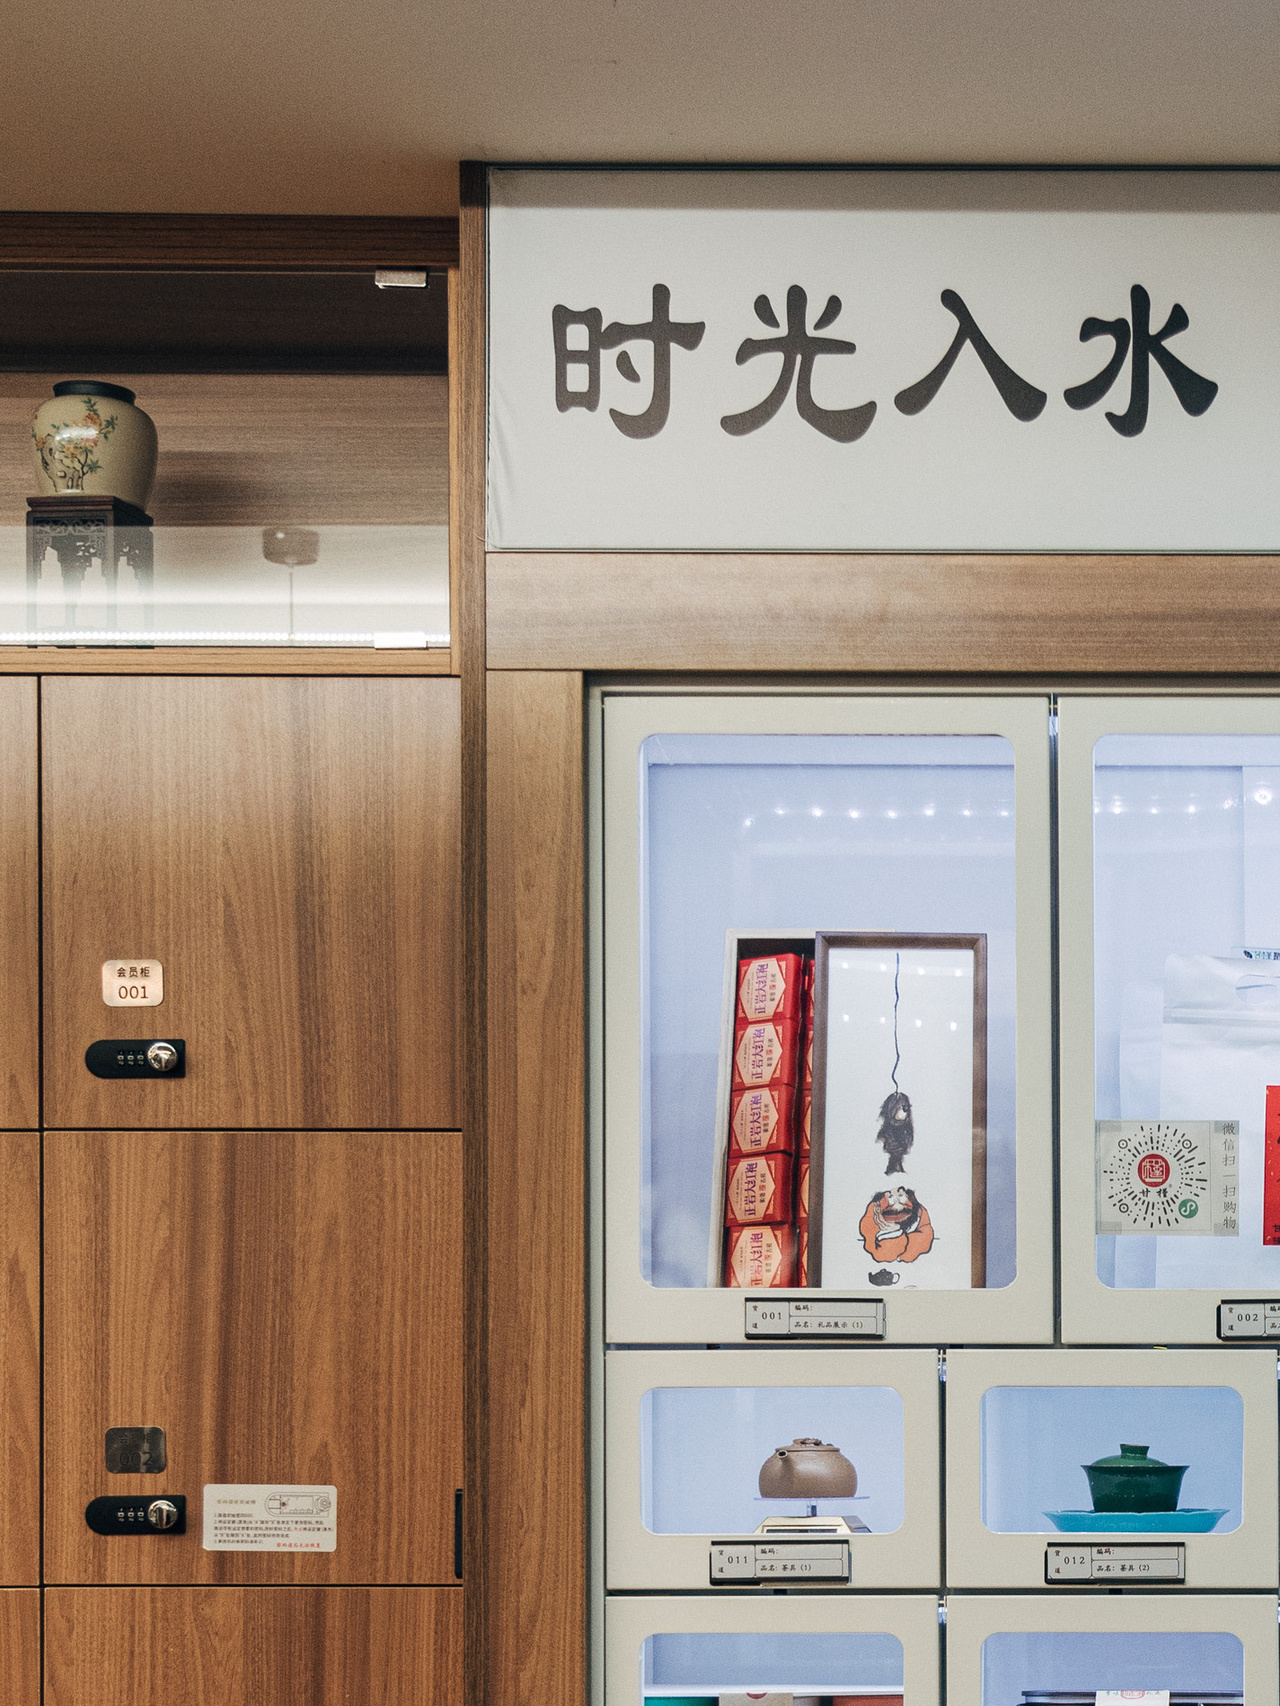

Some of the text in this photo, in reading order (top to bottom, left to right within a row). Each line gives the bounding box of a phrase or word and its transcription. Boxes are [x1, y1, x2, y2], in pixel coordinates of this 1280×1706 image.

[551, 283, 1221, 442] 时光入水
[117, 966, 151, 978] 会员柜
[118, 985, 149, 1000] 001
[755, 963, 769, 1015] 正岩大红袍
[751, 1028, 766, 1080] 正岩大红袍
[750, 1094, 763, 1147] 正岩大红袍
[744, 1162, 758, 1217] 正岩大红袍
[1222, 1122, 1237, 1230] 微信扫一扫购物
[761, 1311, 782, 1320] 001
[1237, 1313, 1259, 1322] 002
[727, 1555, 749, 1564] 011
[1063, 1556, 1086, 1565] 012
